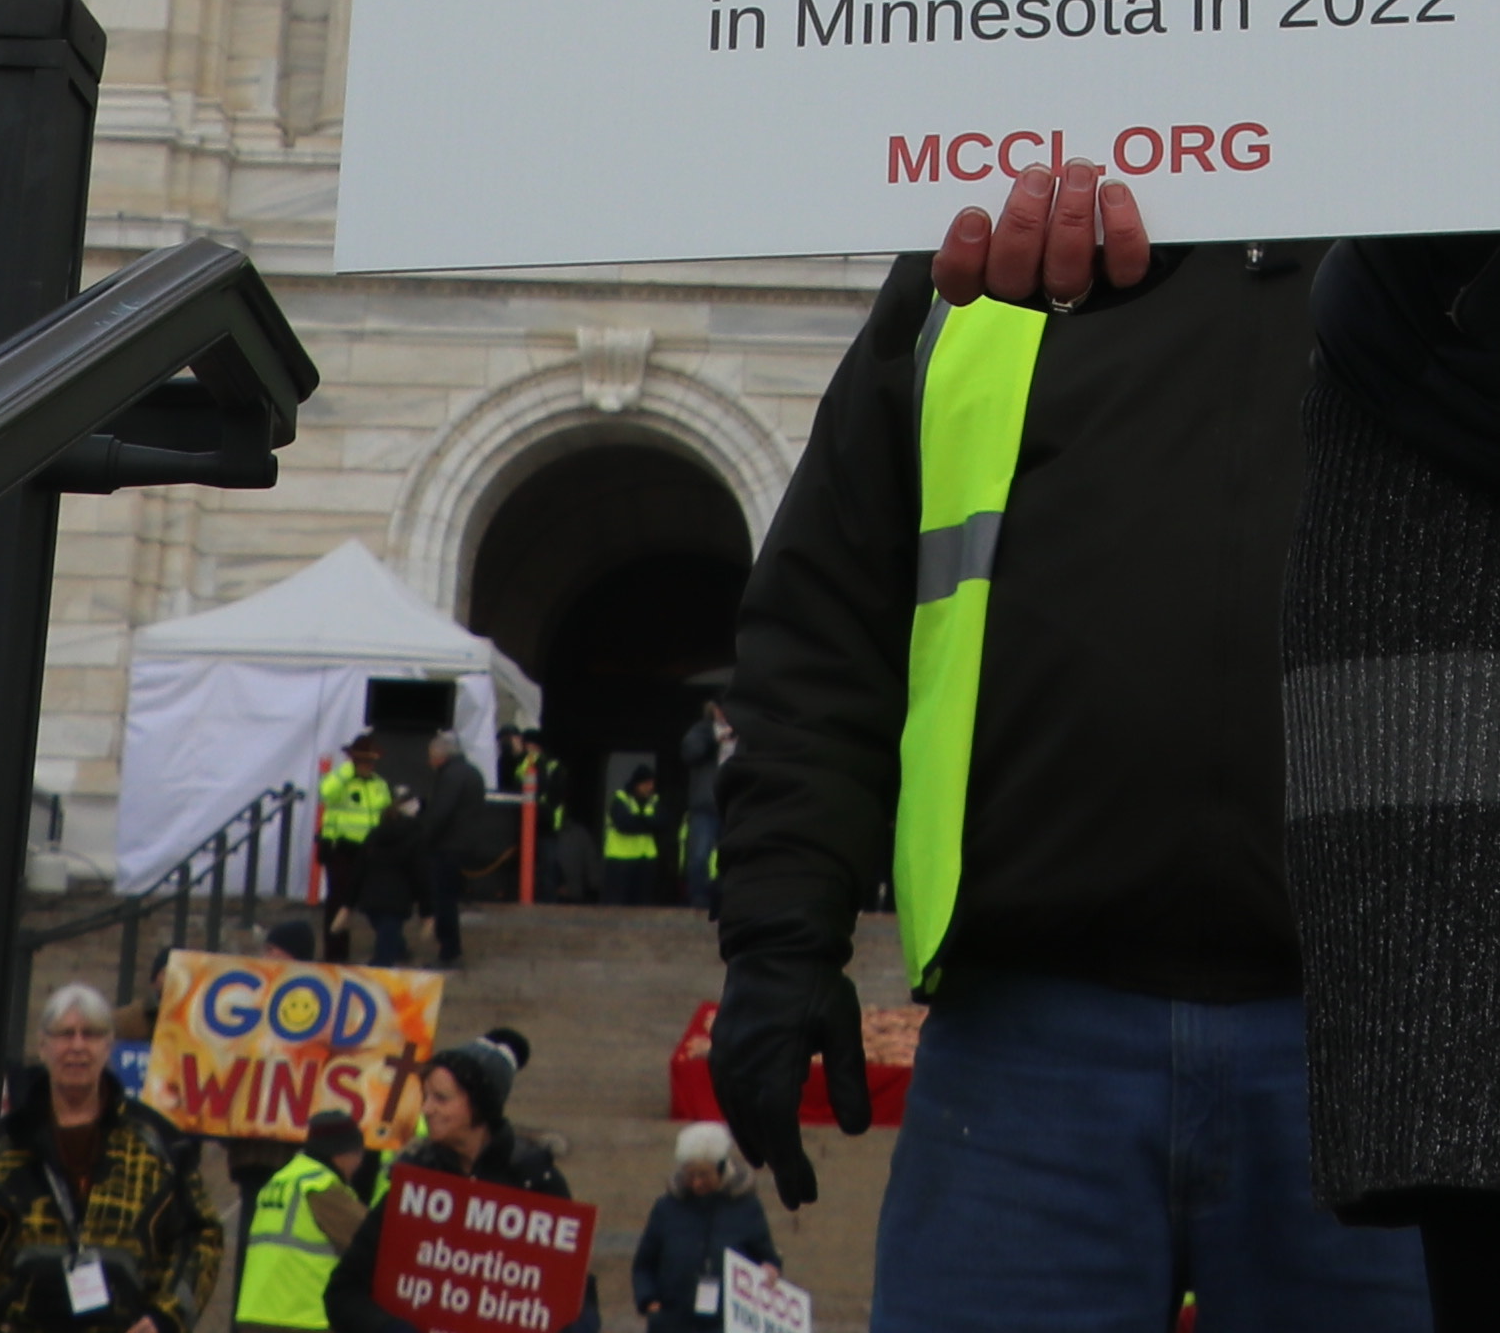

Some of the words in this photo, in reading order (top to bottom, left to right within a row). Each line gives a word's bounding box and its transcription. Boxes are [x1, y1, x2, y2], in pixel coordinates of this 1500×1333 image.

[203, 969, 377, 1048] GOD
[399, 1181, 454, 1224] NO
[463, 1195, 581, 1253] MORE
[415, 1236, 542, 1291] abortion
[396, 1273, 434, 1310] up
[439, 1277, 471, 1313] to
[477, 1284, 551, 1331] birth
